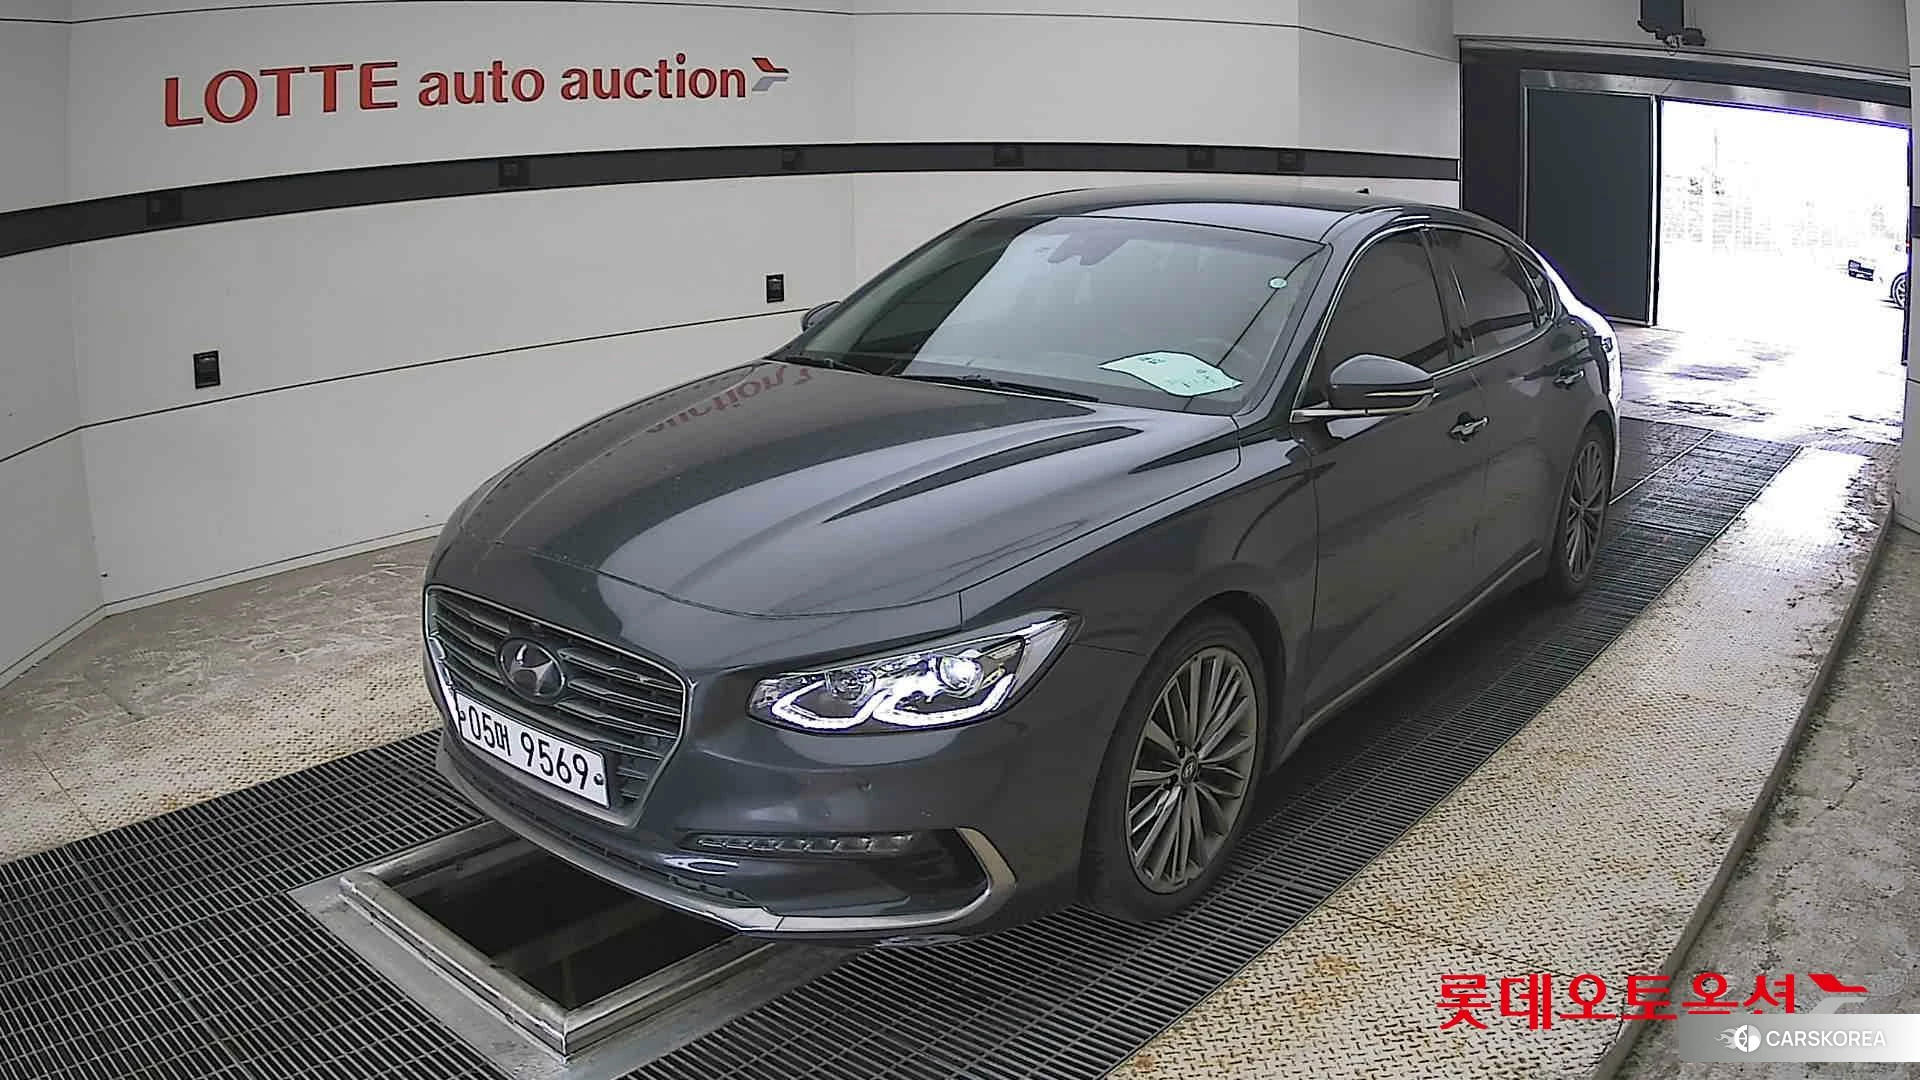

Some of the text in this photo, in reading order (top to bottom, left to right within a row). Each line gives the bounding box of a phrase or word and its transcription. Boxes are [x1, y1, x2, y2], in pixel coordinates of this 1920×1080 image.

[163, 52, 747, 128] LOTTE auto auction
[468, 705, 589, 790] 05머 9569
